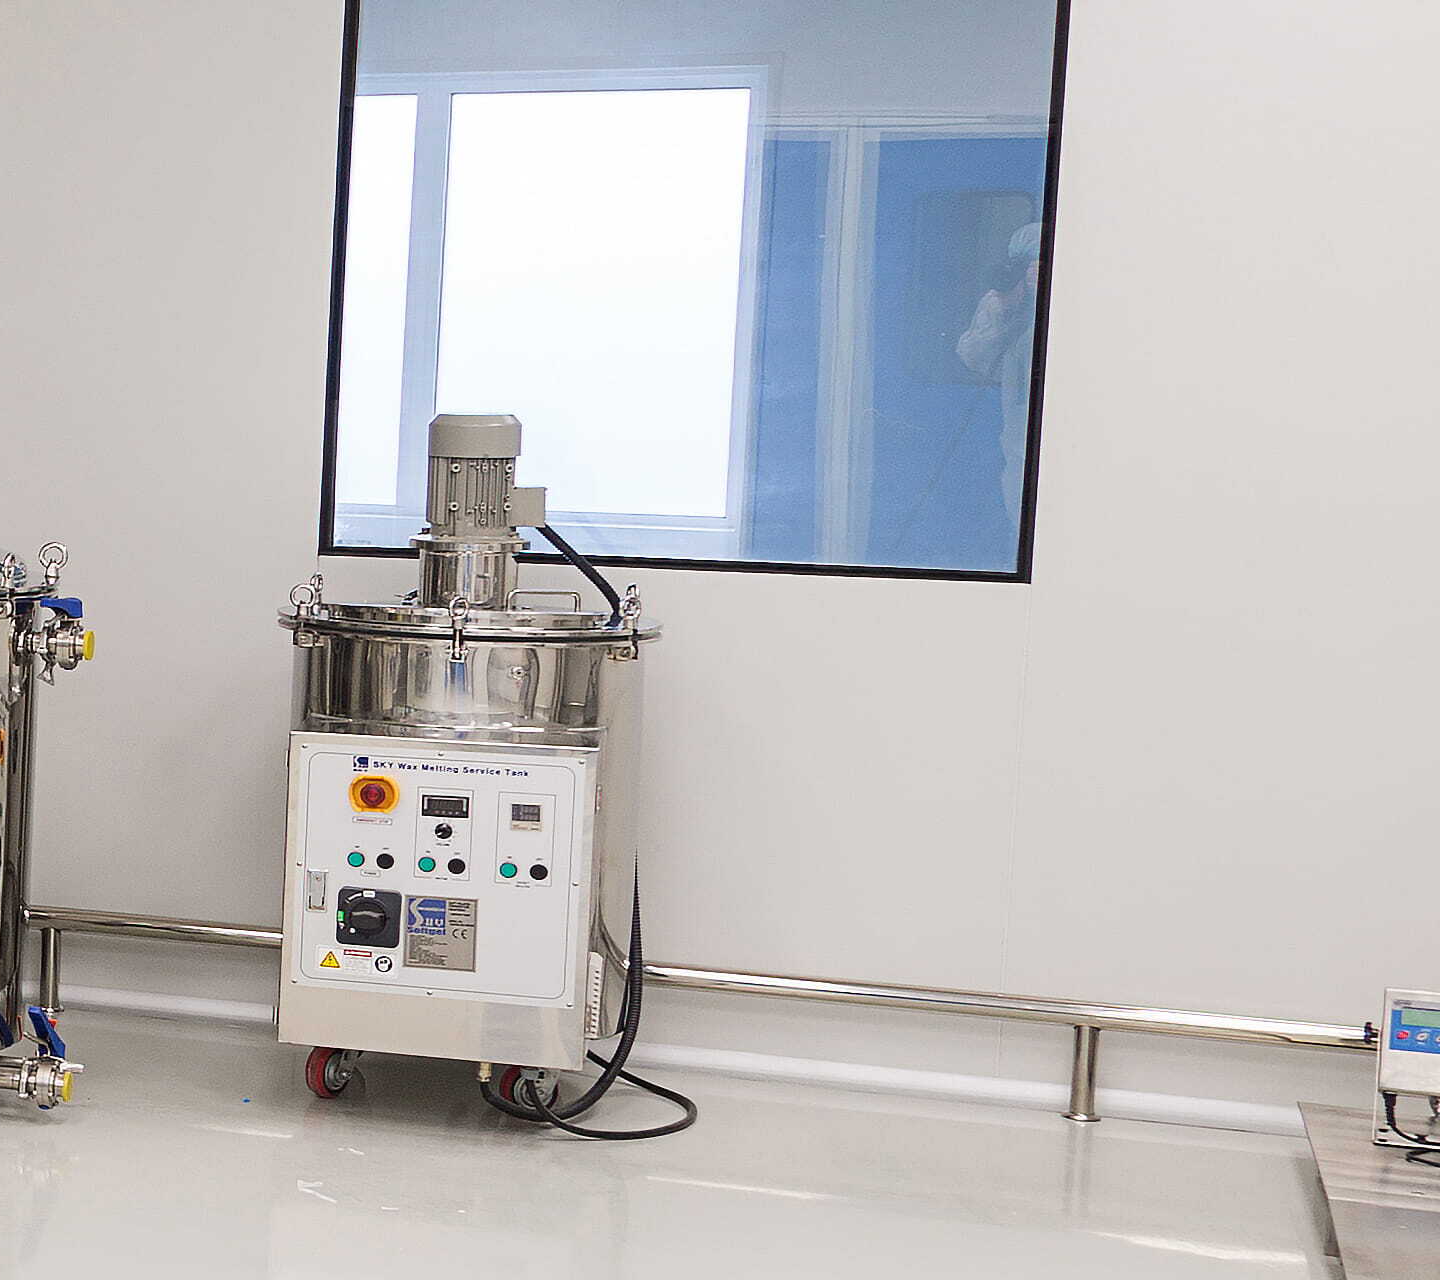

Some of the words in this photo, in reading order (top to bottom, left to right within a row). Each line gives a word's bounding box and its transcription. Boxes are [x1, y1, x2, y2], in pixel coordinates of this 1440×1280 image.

[373, 761, 393, 769] SKY
[421, 764, 459, 774] Melting
[463, 766, 501, 775] Service
